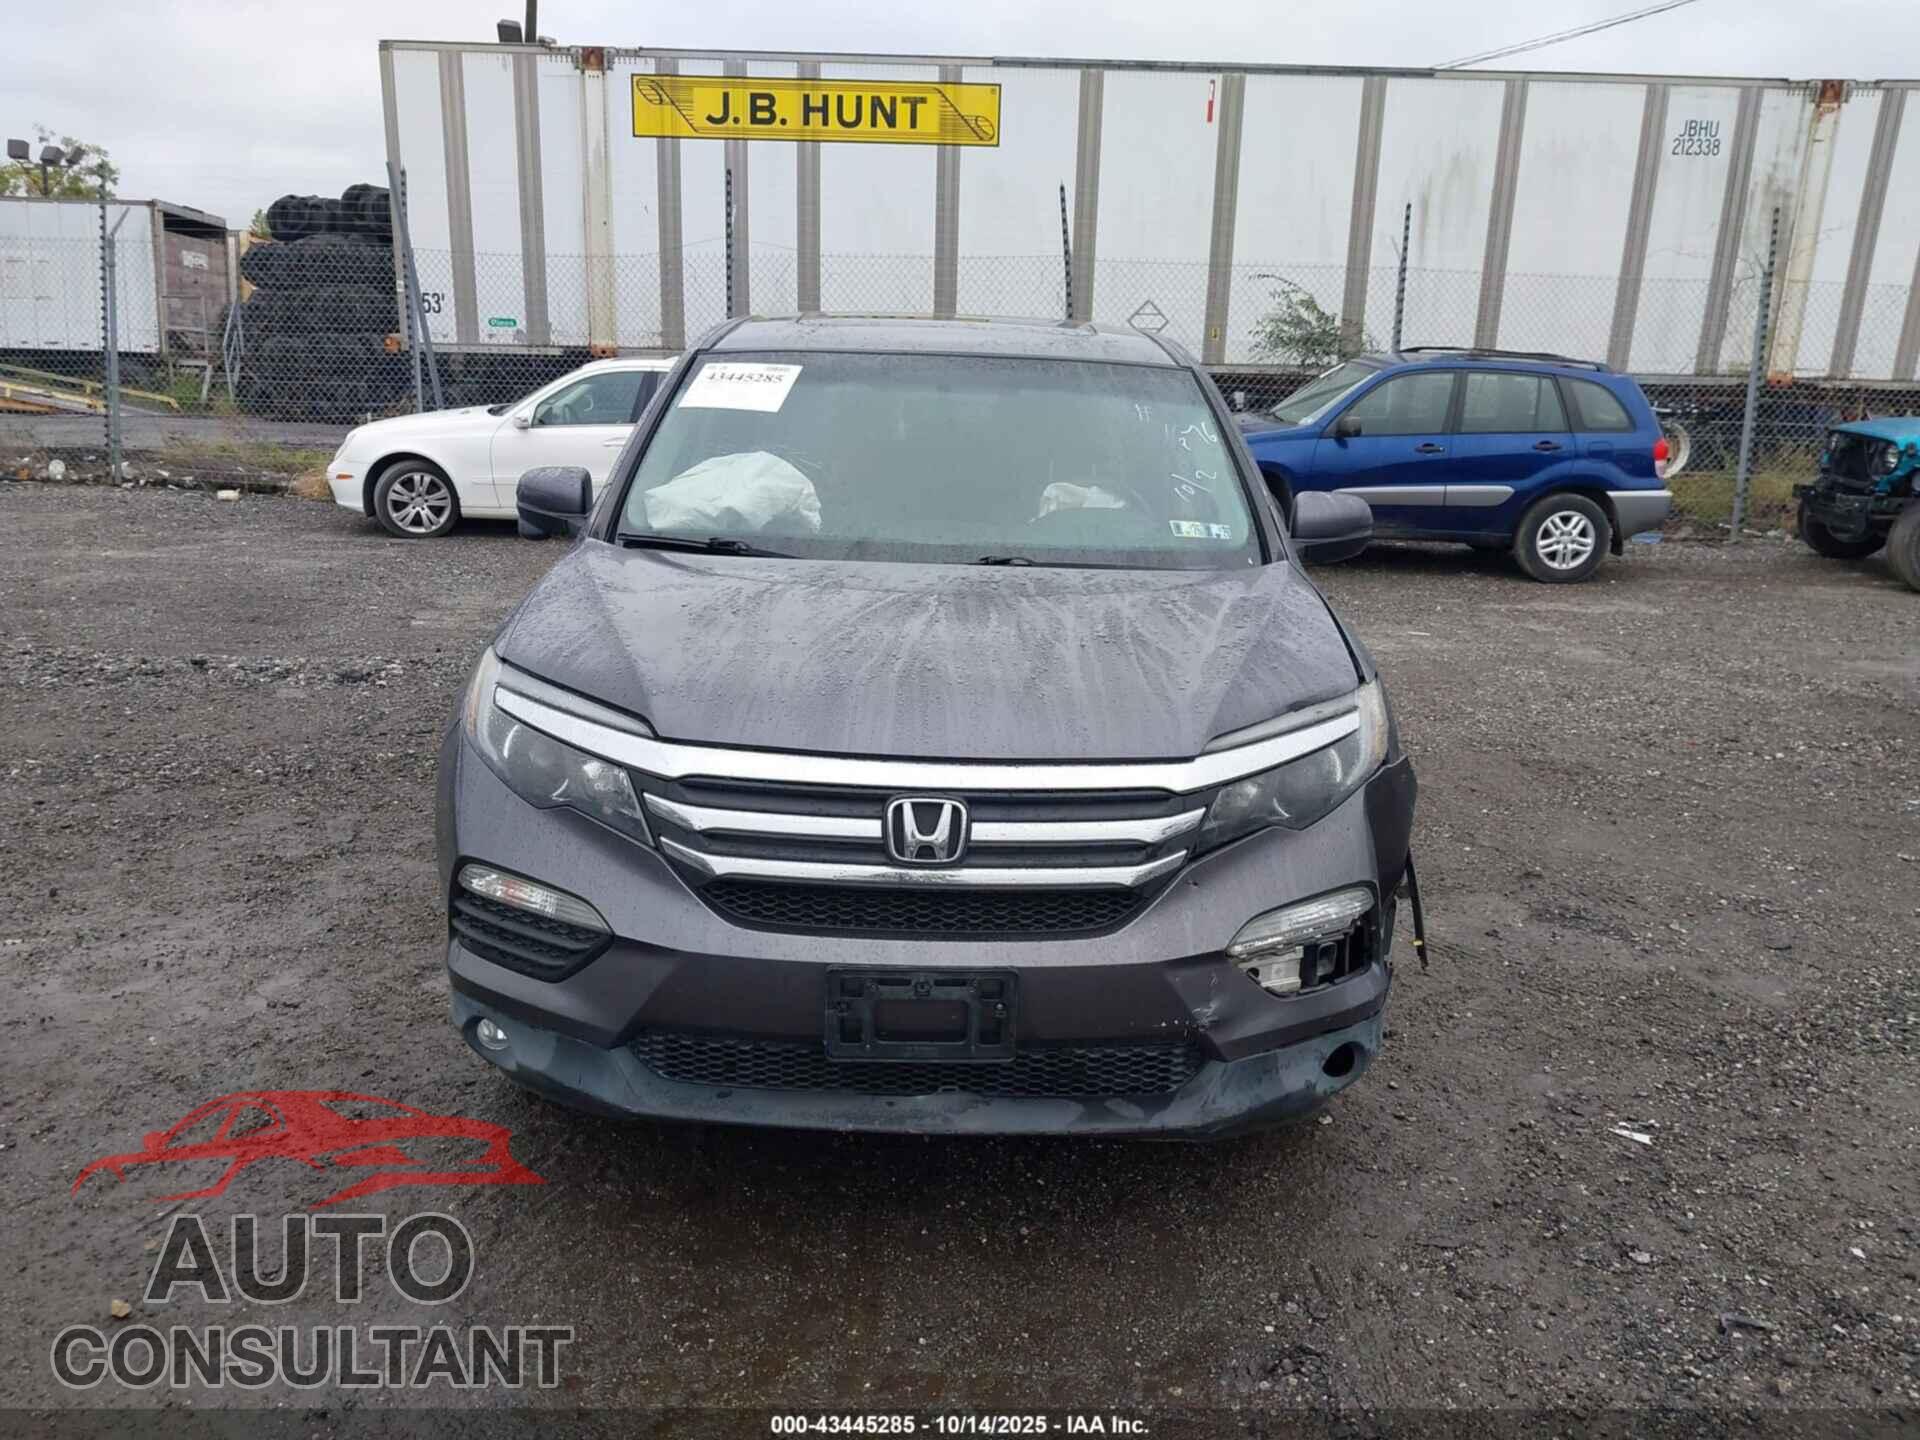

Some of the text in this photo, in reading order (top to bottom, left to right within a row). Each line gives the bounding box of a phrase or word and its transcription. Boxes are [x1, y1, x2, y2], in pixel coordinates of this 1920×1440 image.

[706, 91, 928, 129] J.B. HUNT
[1678, 119, 1720, 137] JBHU
[1671, 138, 1721, 156] 212338
[706, 371, 785, 384] 43445285
